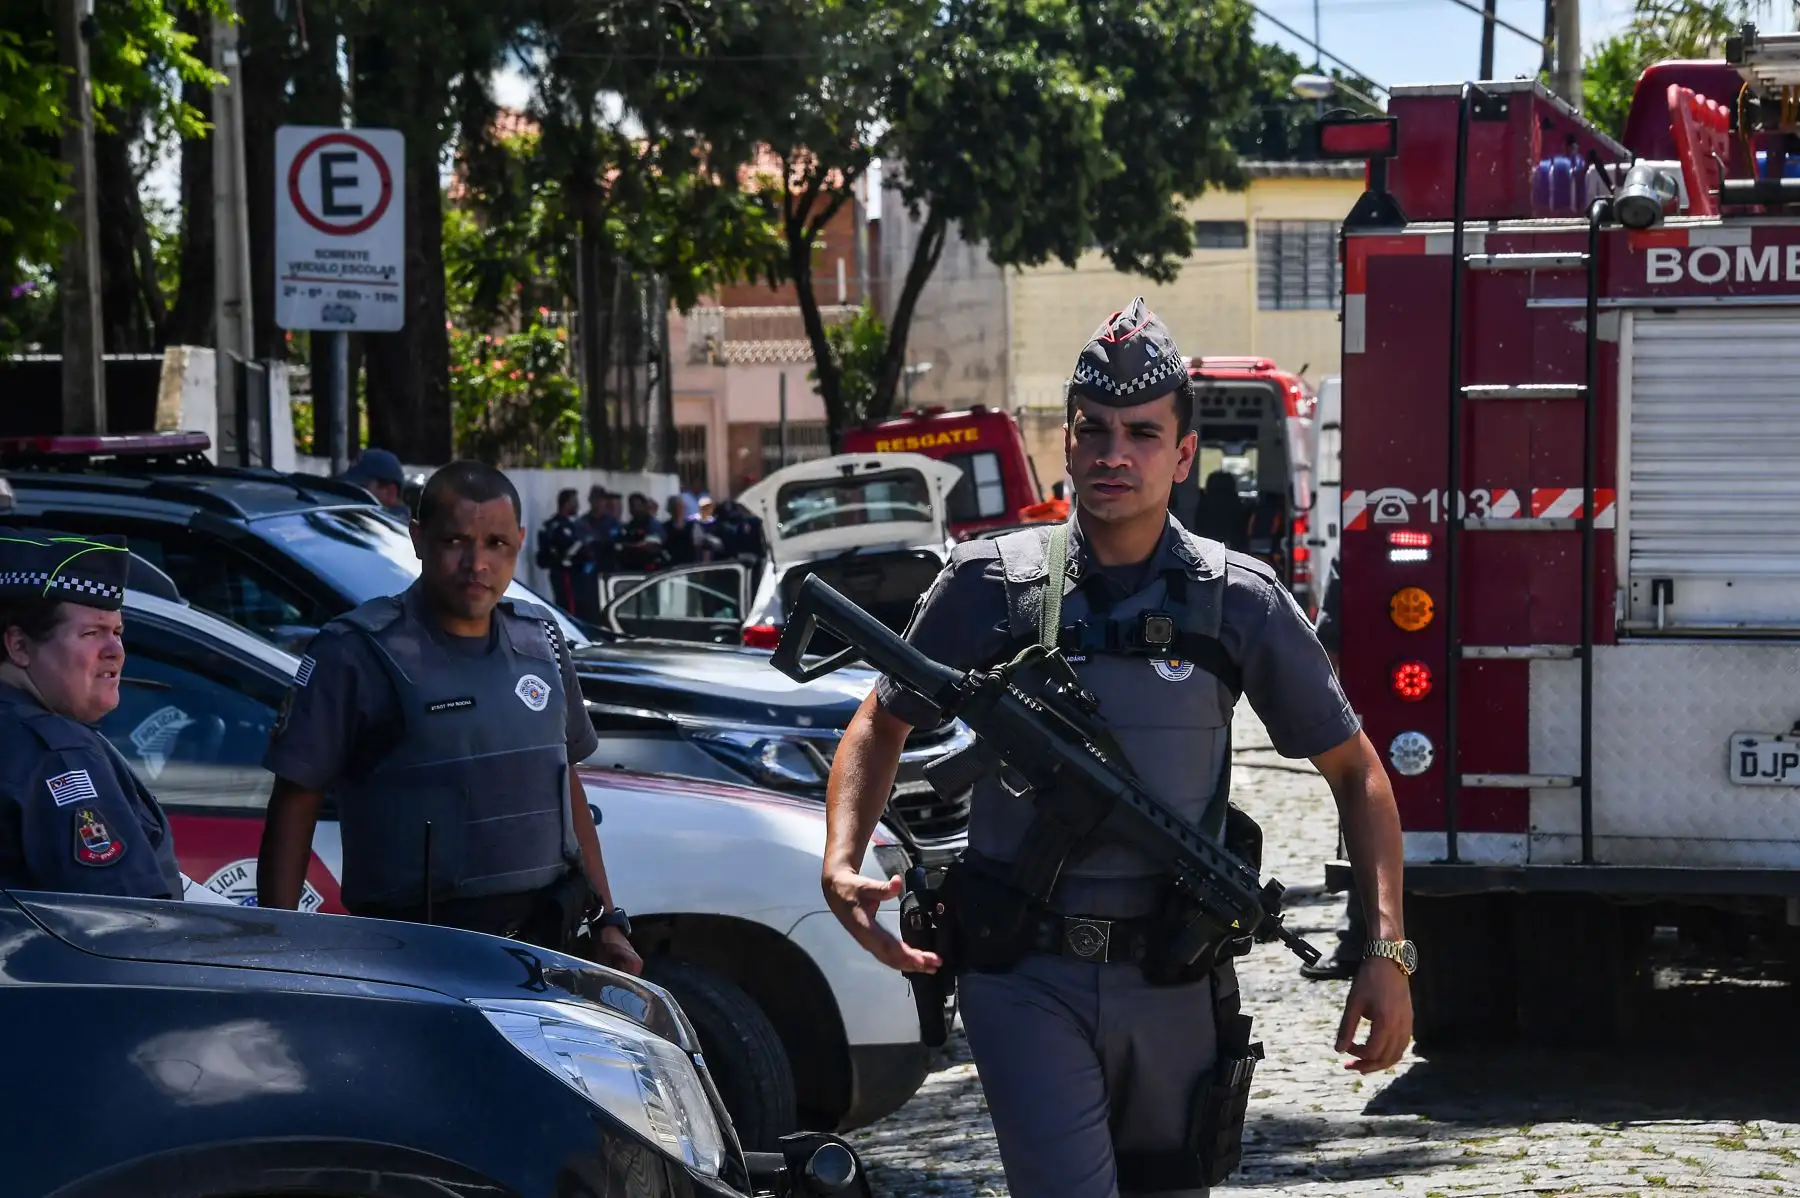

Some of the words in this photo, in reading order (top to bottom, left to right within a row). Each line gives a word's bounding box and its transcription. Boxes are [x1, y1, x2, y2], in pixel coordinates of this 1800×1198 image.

[319, 152, 363, 217] E
[314, 249, 370, 261] SOMENTE
[341, 264, 397, 276] ESCOLAR
[875, 427, 979, 453] RESGATE
[1422, 488, 1491, 523] 193
[1740, 751, 1799, 778] DJP
[209, 866, 248, 895] LICIA
